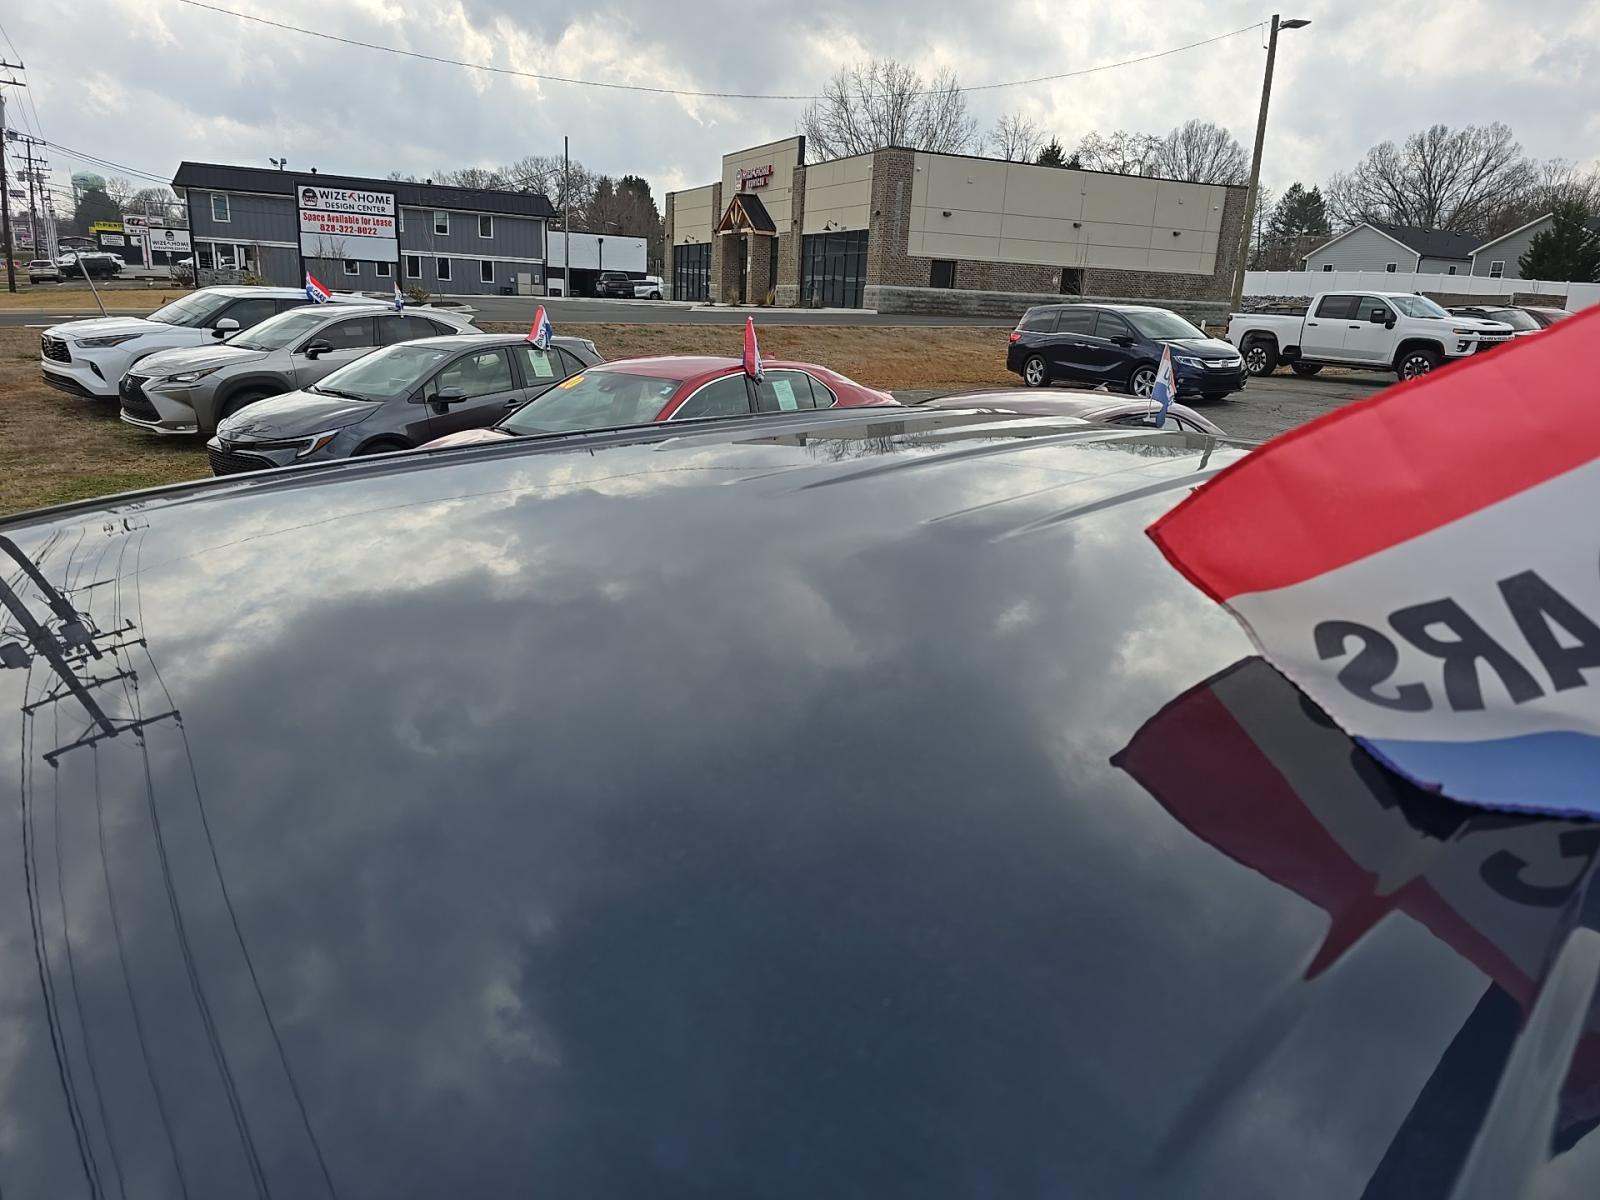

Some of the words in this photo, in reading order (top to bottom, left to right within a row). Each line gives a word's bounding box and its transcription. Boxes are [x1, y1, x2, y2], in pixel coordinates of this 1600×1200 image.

[318, 189, 347, 201] WIZE
[357, 193, 391, 205] HOME
[324, 201, 355, 211] DESIGN
[357, 204, 386, 213] CENTER
[303, 212, 325, 222] Space
[327, 213, 359, 225] Available
[361, 216, 371, 225] for
[373, 217, 392, 227] Lease
[320, 224, 378, 235] 828-322-8022
